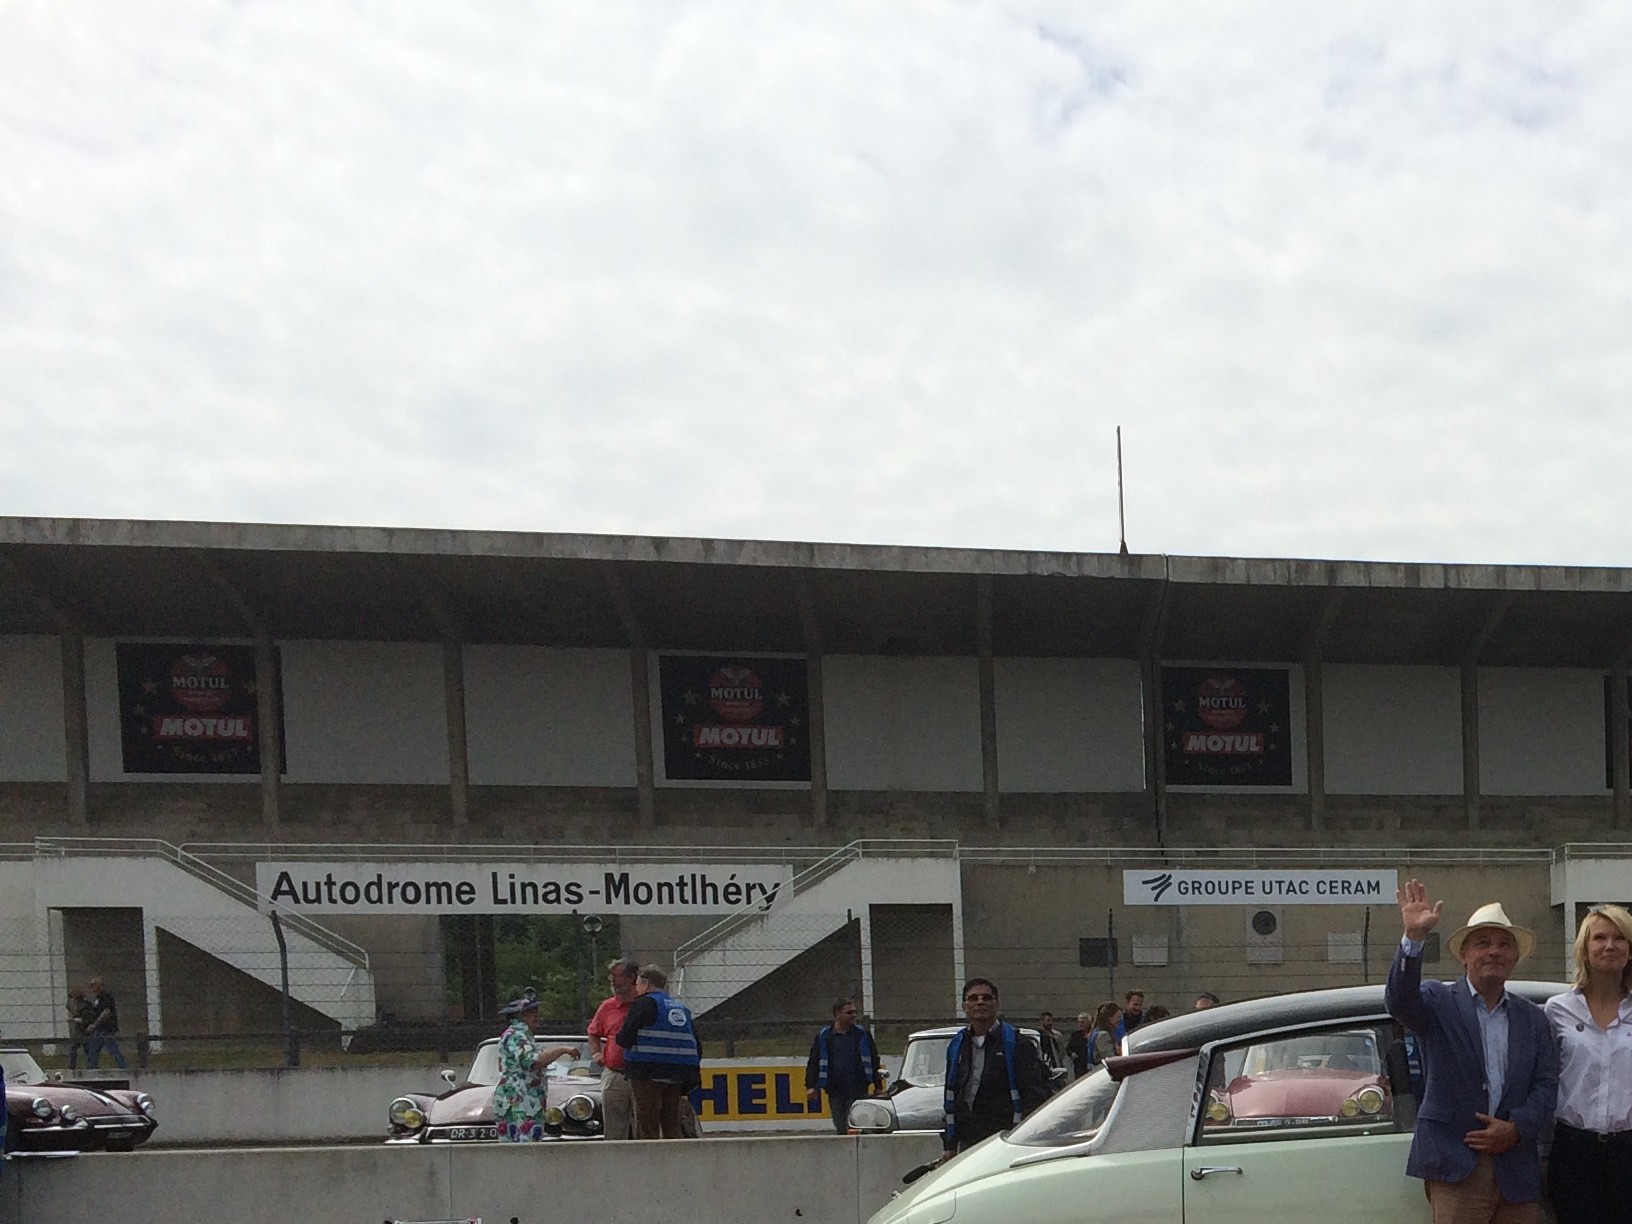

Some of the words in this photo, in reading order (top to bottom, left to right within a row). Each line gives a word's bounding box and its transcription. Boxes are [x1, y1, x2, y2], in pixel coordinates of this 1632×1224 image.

[172, 676, 229, 689] MOTUL
[710, 687, 763, 700] MOTUL
[1198, 696, 1246, 709] MOTUL
[160, 718, 249, 737] MOTUL
[699, 727, 780, 746] MOTUL
[1187, 735, 1260, 752] MOTUL
[270, 870, 477, 905] Autodrome
[491, 871, 782, 911] Linas-Montlhéry
[1177, 880, 1255, 896] GROUPE
[1261, 880, 1310, 895] UTAC
[1316, 879, 1381, 895] CERAM
[688, 1073, 822, 1115] HEL
